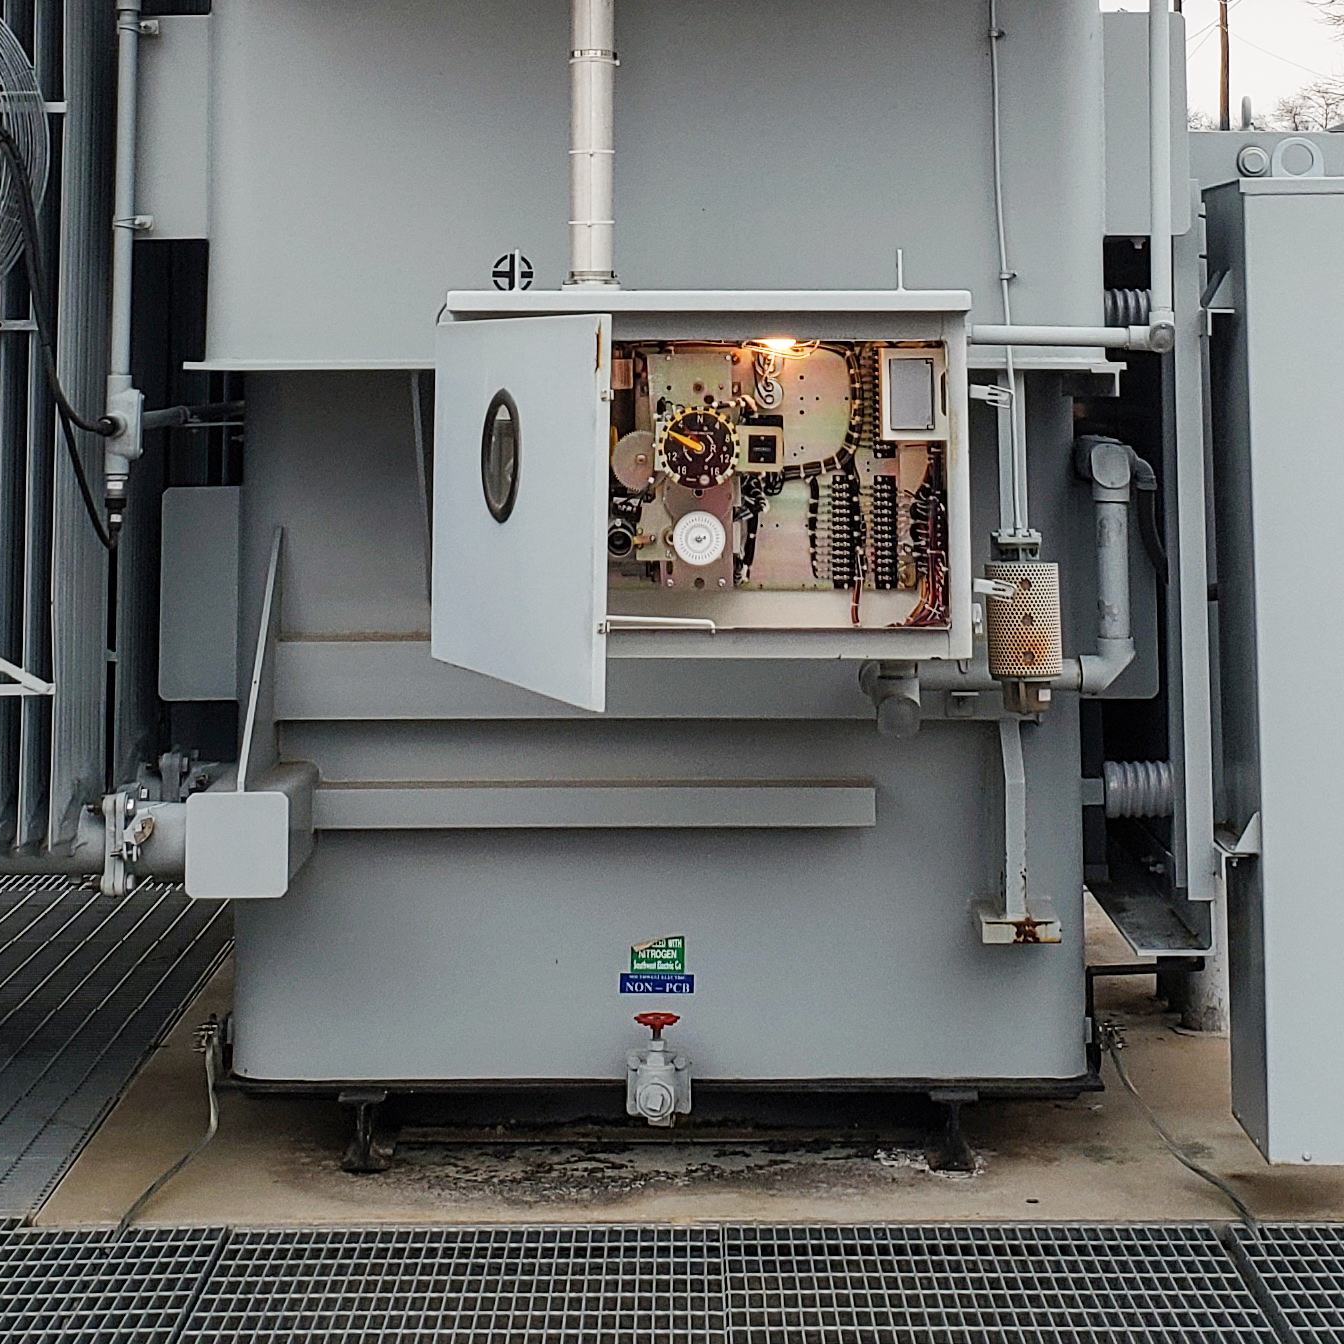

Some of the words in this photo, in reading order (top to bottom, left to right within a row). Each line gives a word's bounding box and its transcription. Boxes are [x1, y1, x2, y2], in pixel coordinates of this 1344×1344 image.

[697, 416, 704, 424] N
[715, 421, 721, 430] 4
[710, 444, 717, 453] R
[668, 452, 678, 462] 12
[720, 454, 730, 463] 12
[710, 467, 720, 476] 16
[668, 938, 682, 948] WITH
[638, 949, 677, 959] NITROGEN
[625, 981, 653, 992] NON
[665, 982, 690, 993] PCB
